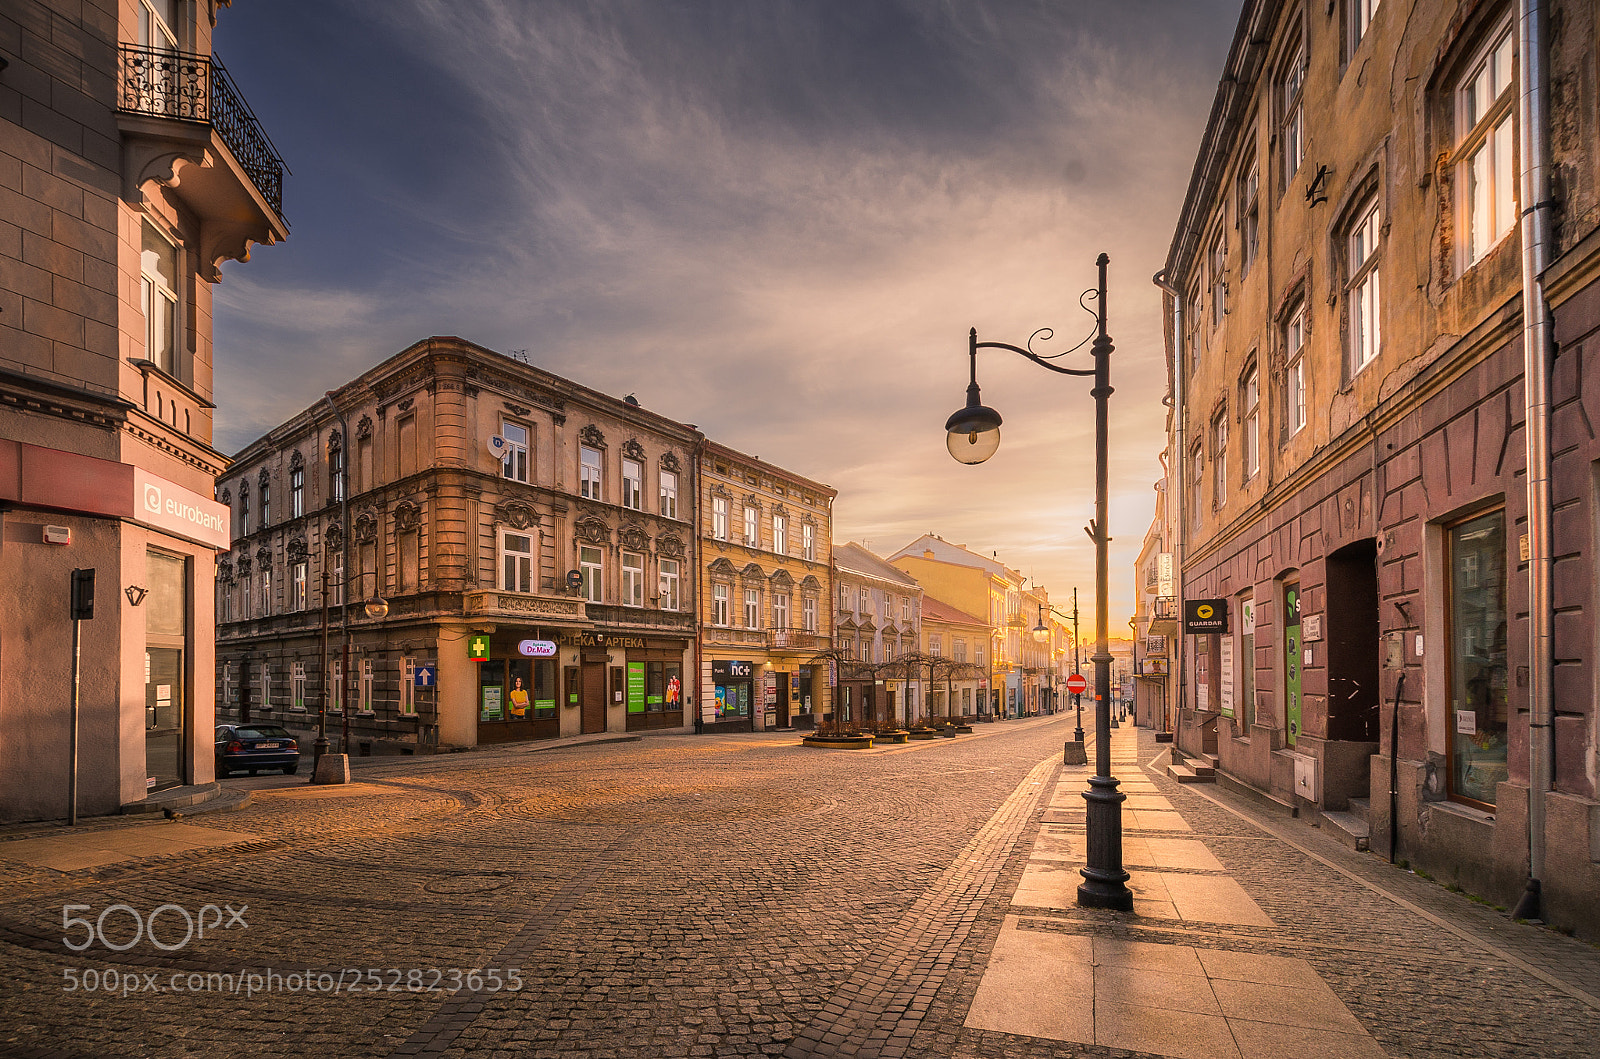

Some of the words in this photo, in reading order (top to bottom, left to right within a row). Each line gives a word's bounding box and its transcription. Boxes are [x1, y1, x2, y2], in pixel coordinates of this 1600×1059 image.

[166, 498, 224, 534] eurobank
[552, 634, 595, 646] APTEKA
[605, 637, 645, 648] APTEKA
[527, 645, 551, 653] Dr.Max
[731, 665, 750, 676] nc+
